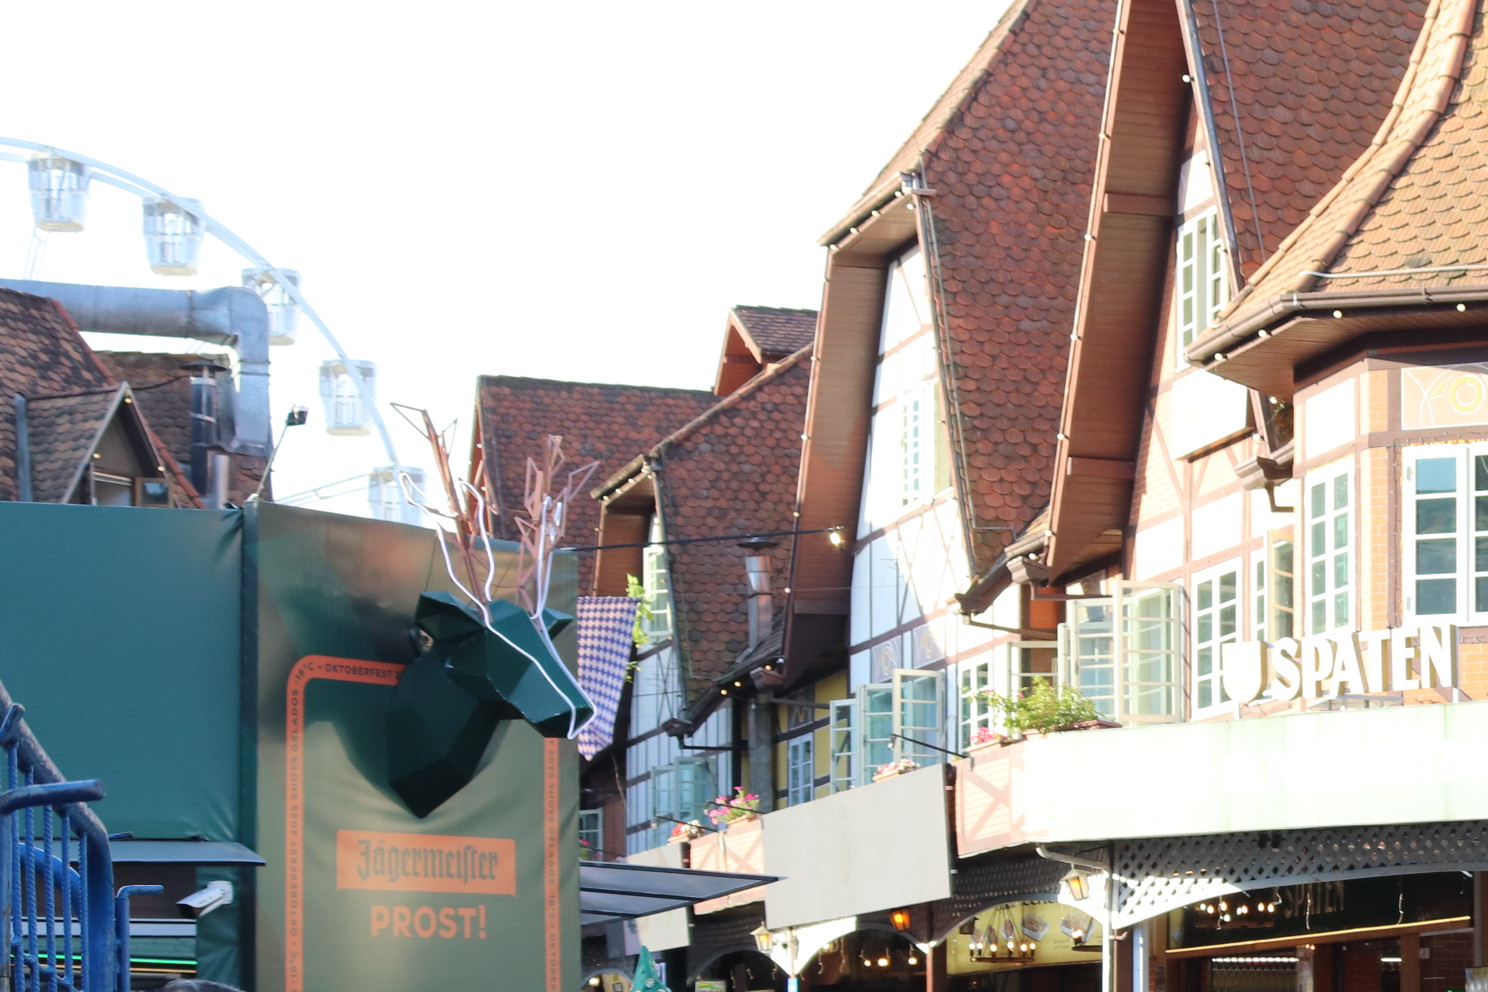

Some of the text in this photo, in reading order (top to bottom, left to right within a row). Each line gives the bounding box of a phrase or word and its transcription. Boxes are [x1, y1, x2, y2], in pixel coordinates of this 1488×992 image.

[324, 664, 392, 679] OKTOBERFEST
[1262, 625, 1459, 700] SPATEN
[290, 688, 298, 752] GELADOS
[370, 905, 487, 940] PROST!
